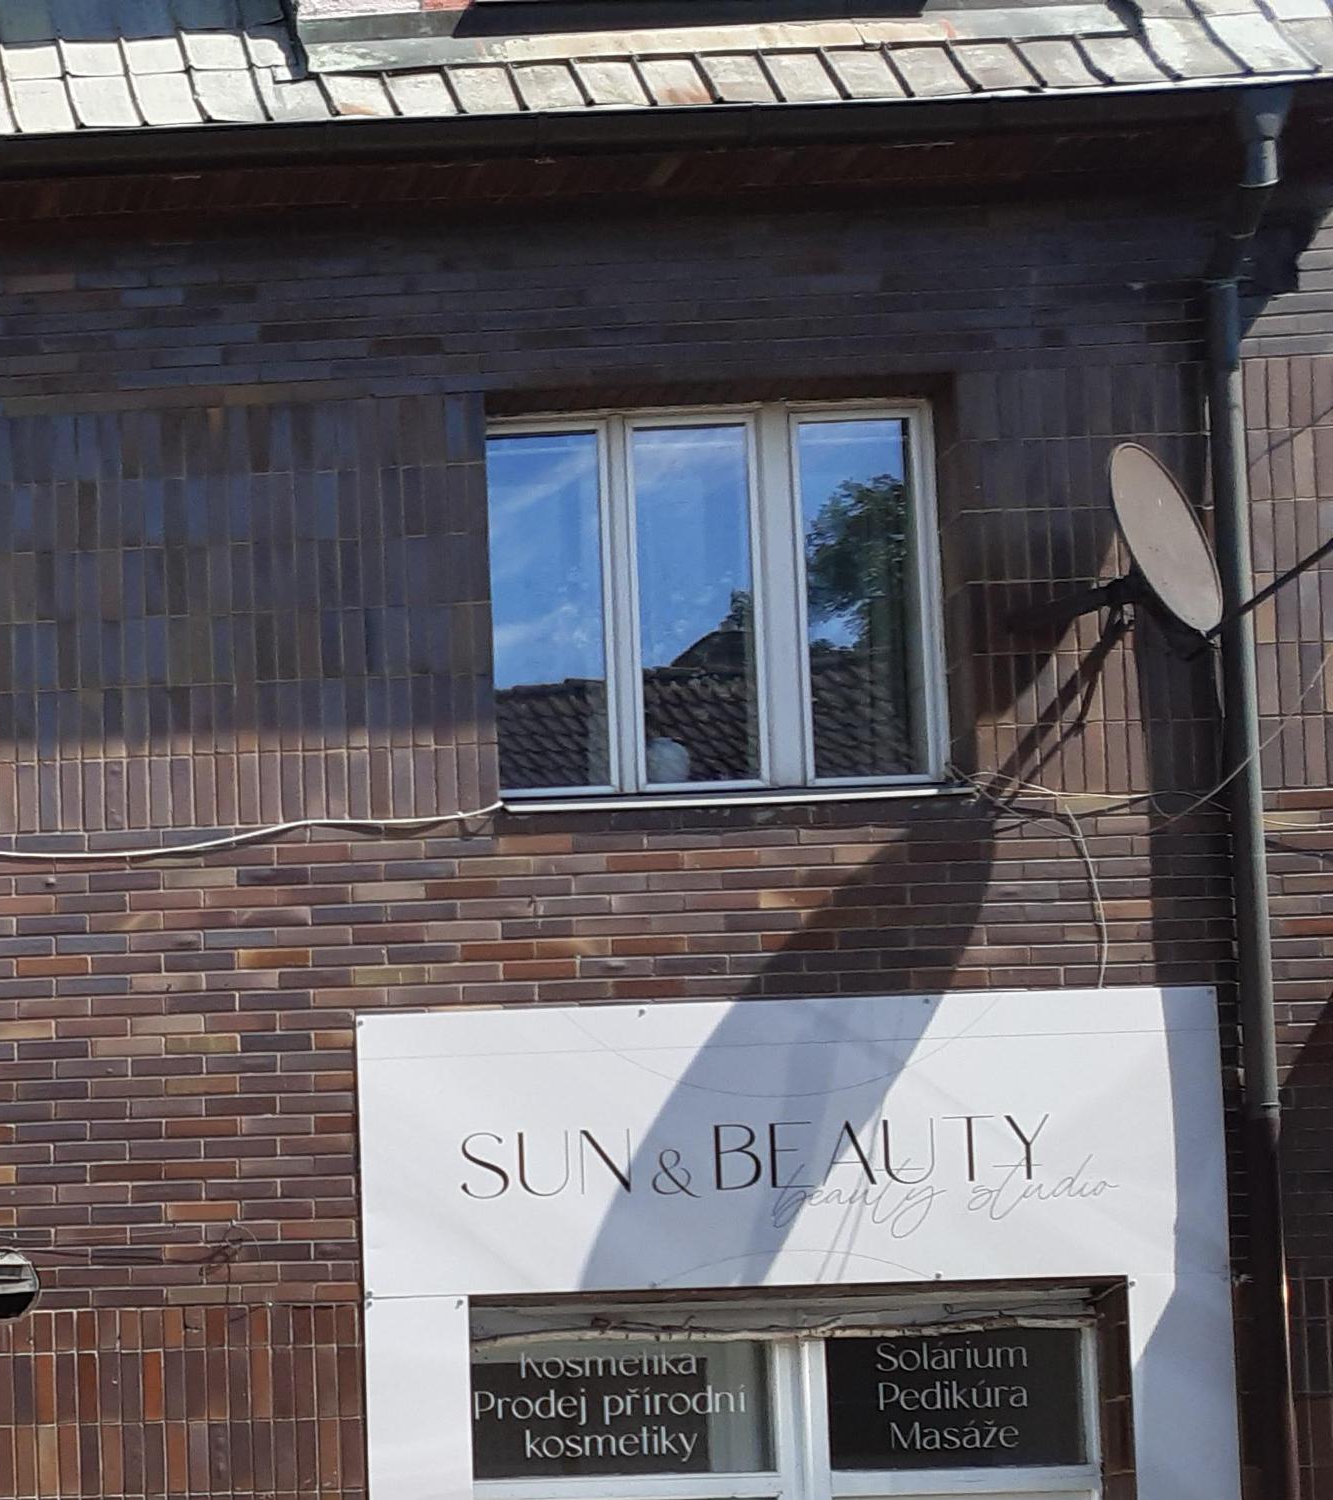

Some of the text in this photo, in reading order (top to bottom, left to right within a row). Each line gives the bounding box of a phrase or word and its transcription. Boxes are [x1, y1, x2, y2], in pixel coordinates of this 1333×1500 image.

[461, 1113, 1049, 1199] SUN & BEAUTY
[771, 1154, 1120, 1238] beauty studio
[876, 1340, 1028, 1371] Solárium
[473, 1384, 746, 1425] Prodej přírodní
[878, 1379, 1028, 1411] Pedikúra
[525, 1425, 698, 1462] kosmetiky
[889, 1420, 1019, 1450] Masáže
